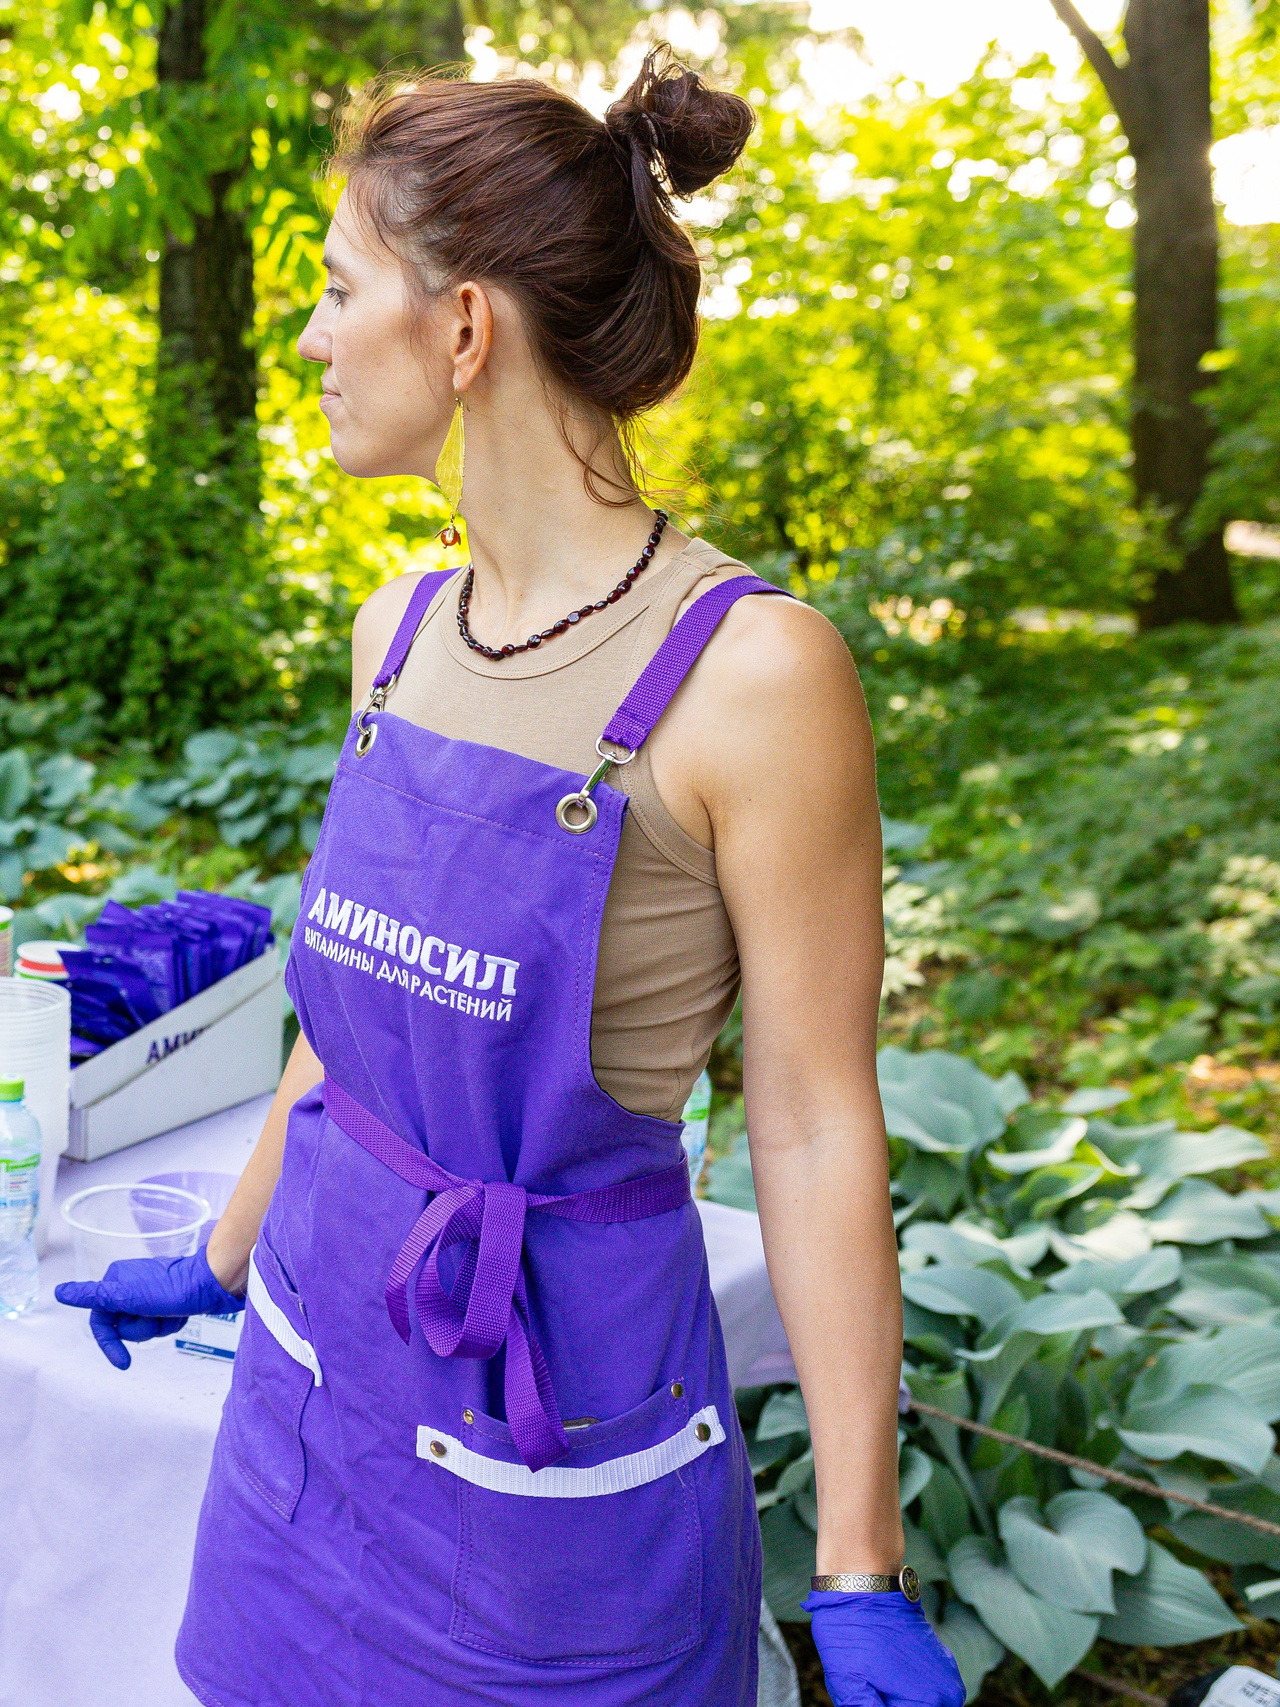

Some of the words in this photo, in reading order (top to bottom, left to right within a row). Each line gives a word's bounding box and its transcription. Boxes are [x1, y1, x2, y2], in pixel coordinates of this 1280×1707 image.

[304, 926, 374, 974] ВИТАМИНЫ
[376, 960, 409, 990] ДЛЯ
[410, 974, 513, 1022] РАСТЕНИЙ
[307, 887, 520, 996] АМИНОСИЛ
